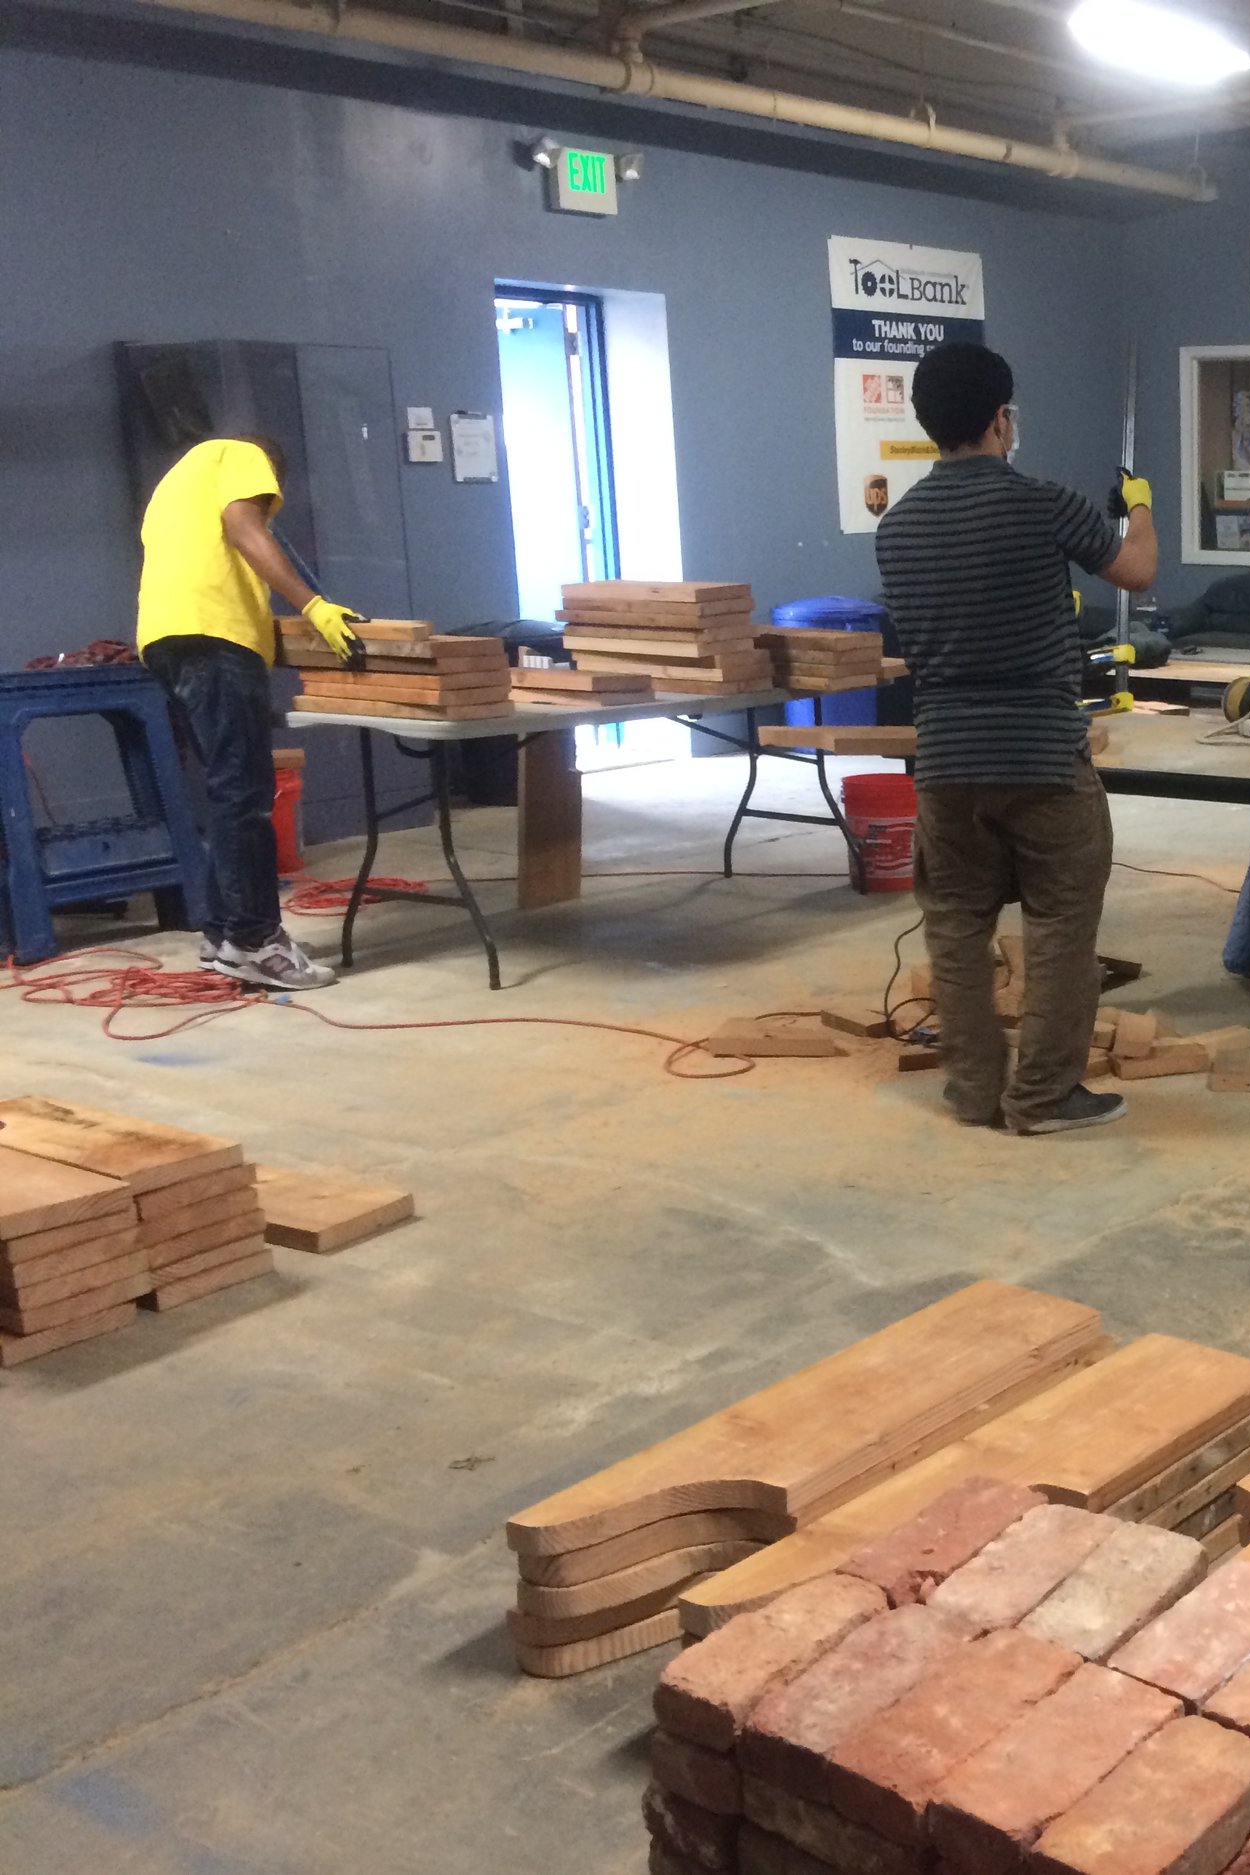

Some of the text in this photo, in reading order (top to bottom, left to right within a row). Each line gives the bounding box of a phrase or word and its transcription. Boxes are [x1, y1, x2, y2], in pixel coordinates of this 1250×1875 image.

[567, 150, 606, 194] EXIT
[871, 319, 944, 341] THANK YOU
[852, 338, 863, 351] to
[865, 341, 881, 352] our
[884, 340, 925, 358] founding
[865, 487, 888, 512] ups
